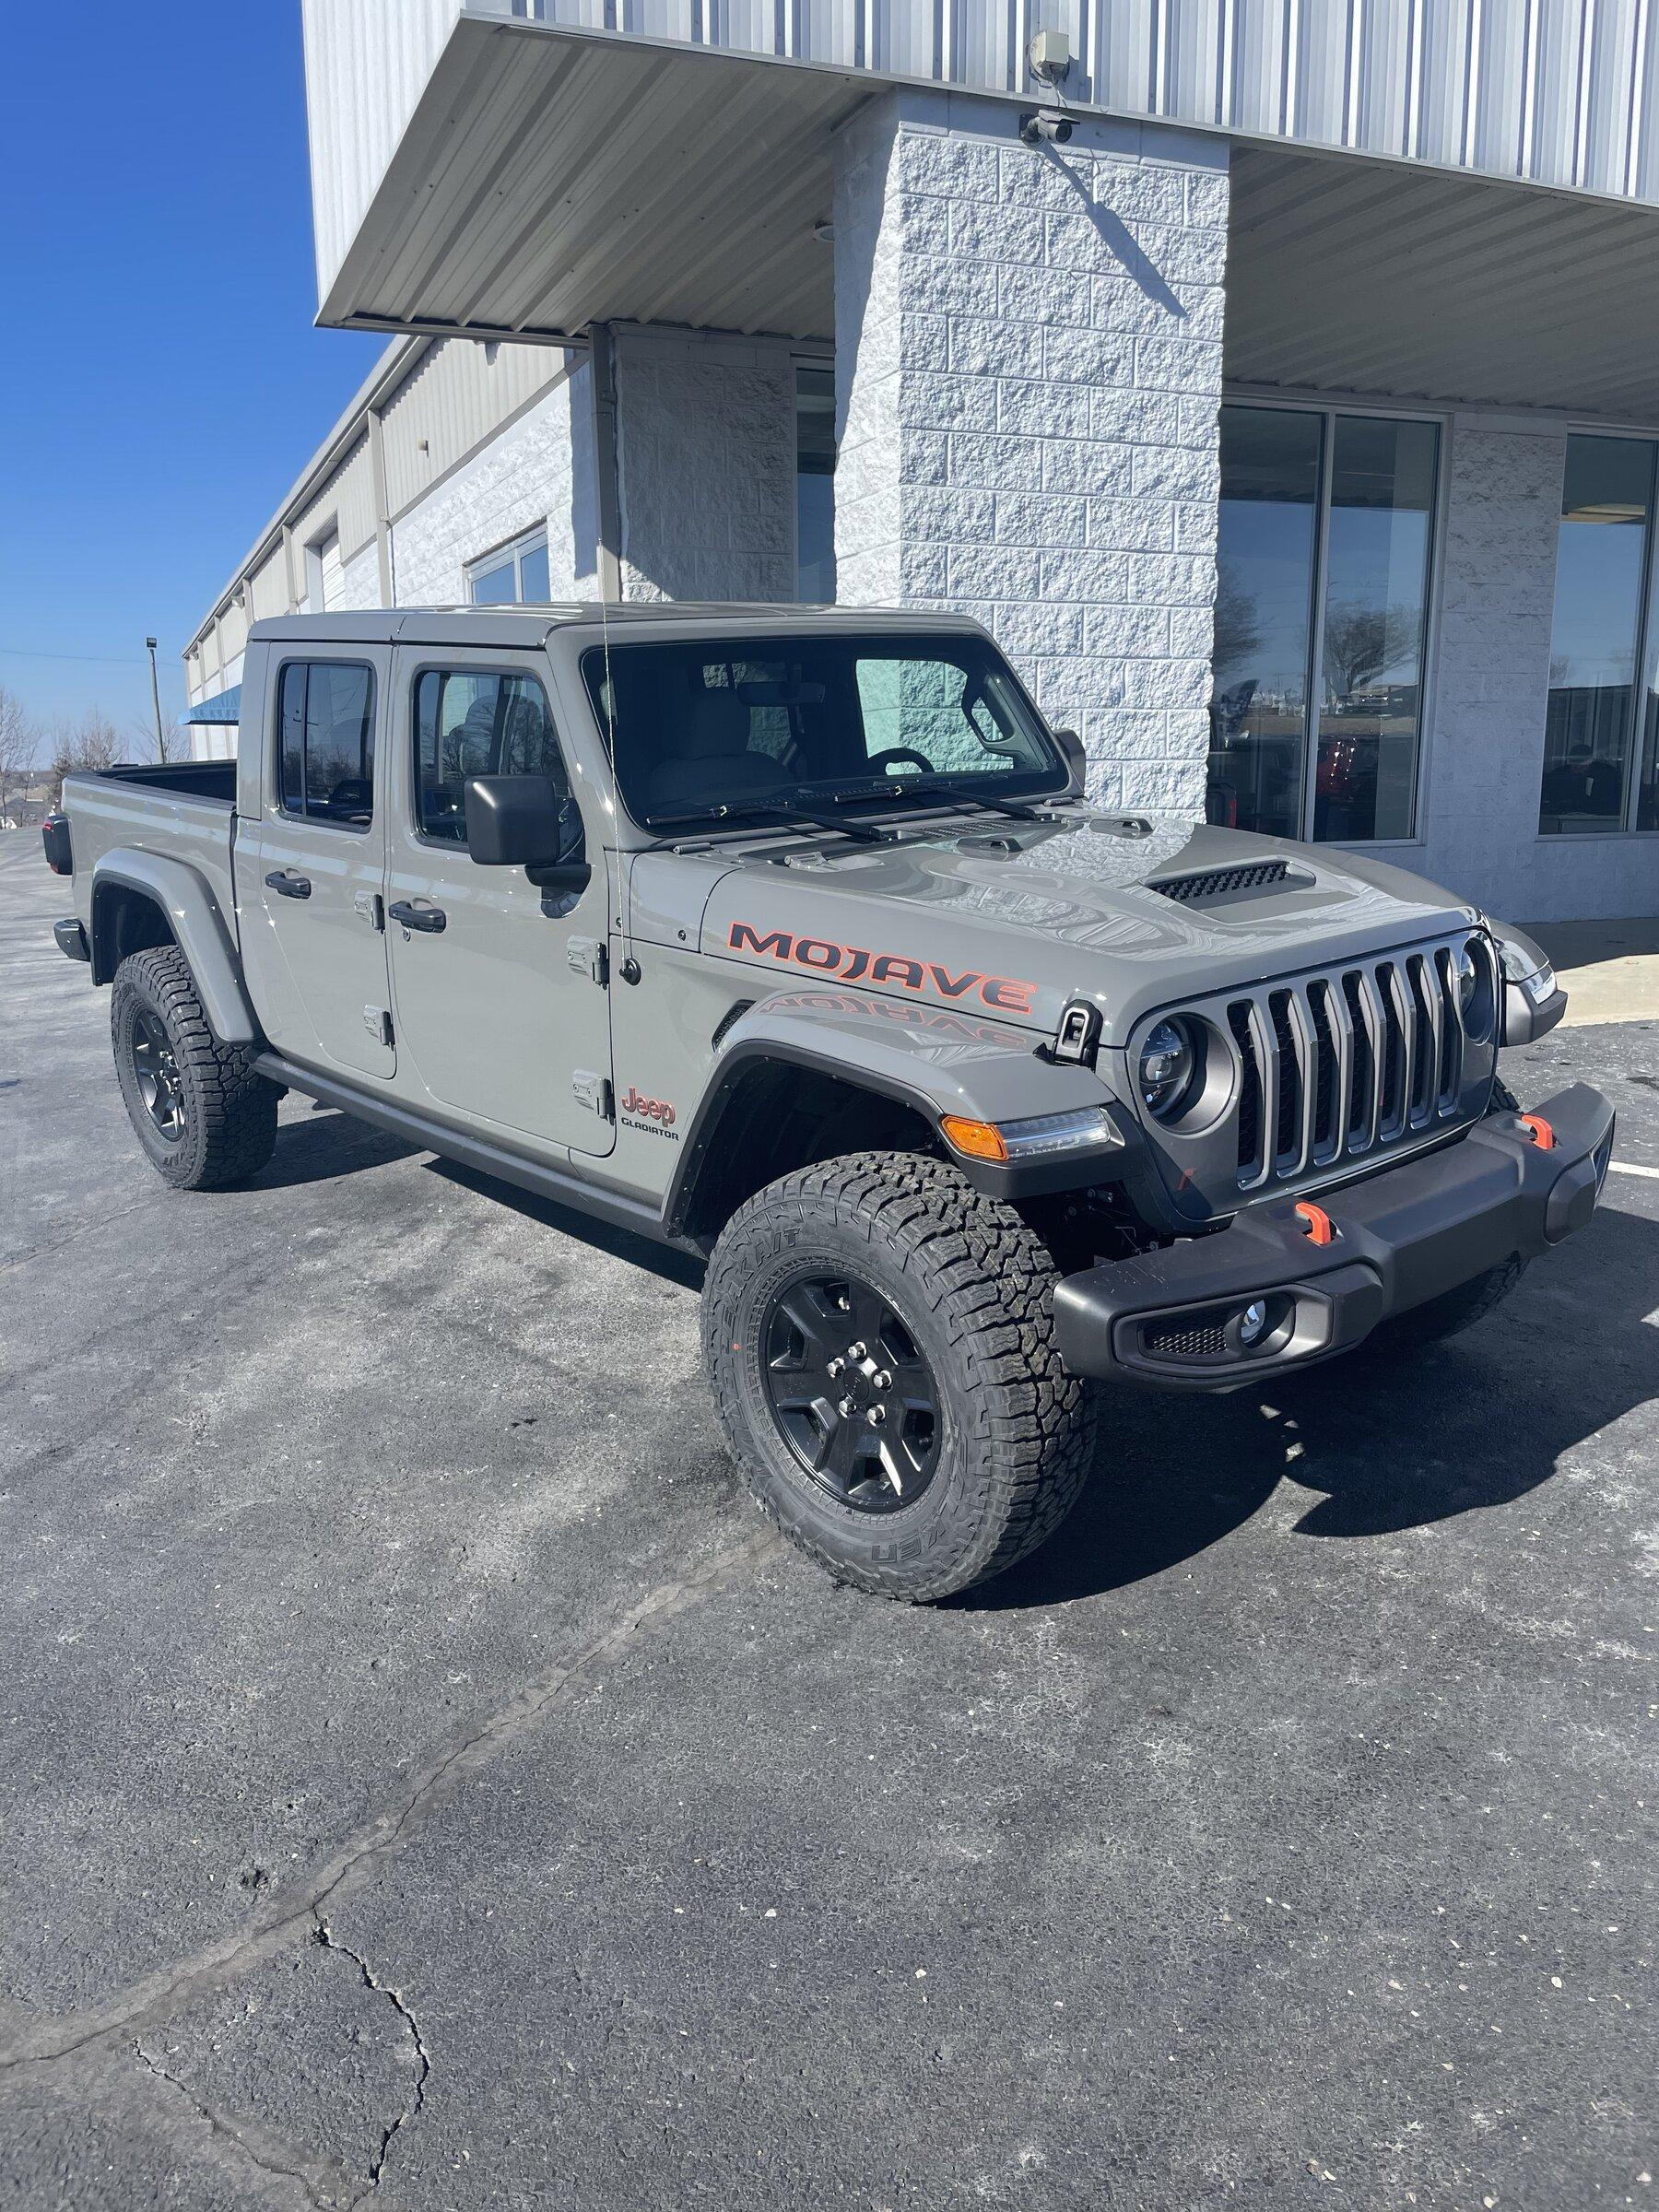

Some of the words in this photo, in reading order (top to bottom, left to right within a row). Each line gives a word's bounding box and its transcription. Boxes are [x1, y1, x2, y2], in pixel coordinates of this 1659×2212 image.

[728, 921, 1038, 1016] MOJAVE
[621, 1087, 676, 1128] Jeep
[621, 1116, 679, 1141] GLADIATOR
